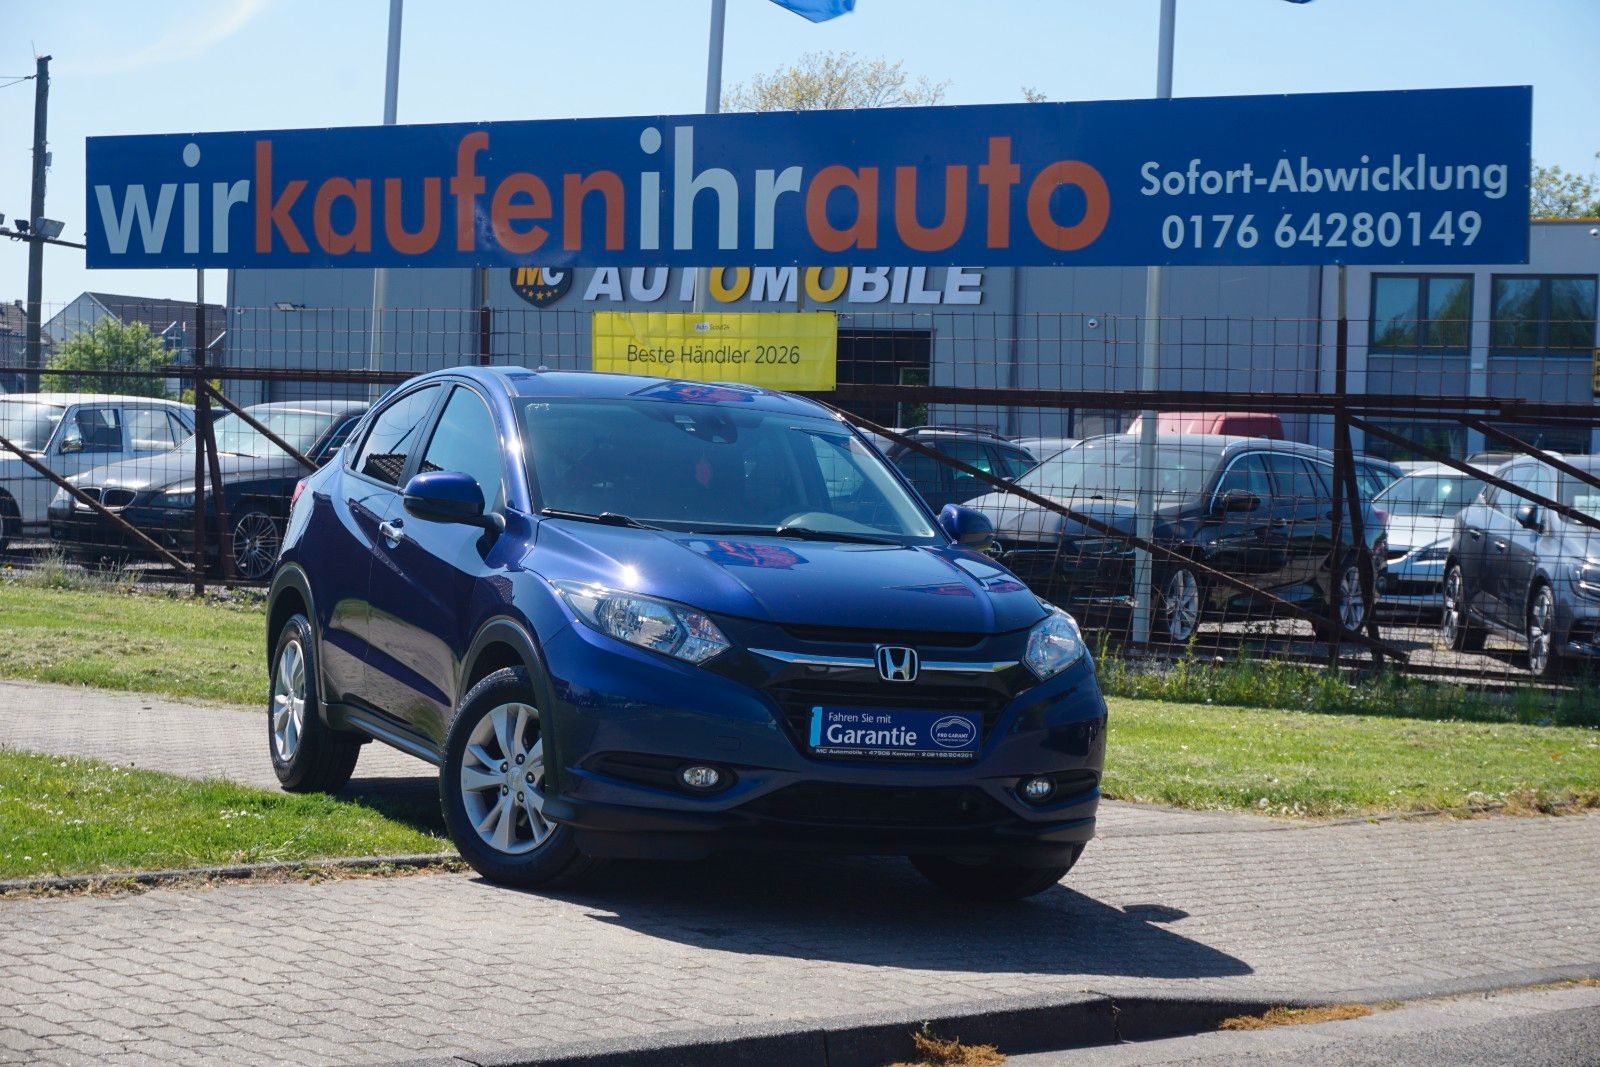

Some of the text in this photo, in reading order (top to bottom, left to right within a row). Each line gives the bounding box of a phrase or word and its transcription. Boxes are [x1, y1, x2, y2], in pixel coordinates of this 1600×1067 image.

[1140, 153, 1508, 199] Sofort-Abwicklung
[1162, 210, 1482, 249] 0176 64280149
[627, 344, 800, 364] Beste Händler 2026
[828, 712, 891, 724] Fahren Sie mit
[827, 724, 917, 745] Garantie
